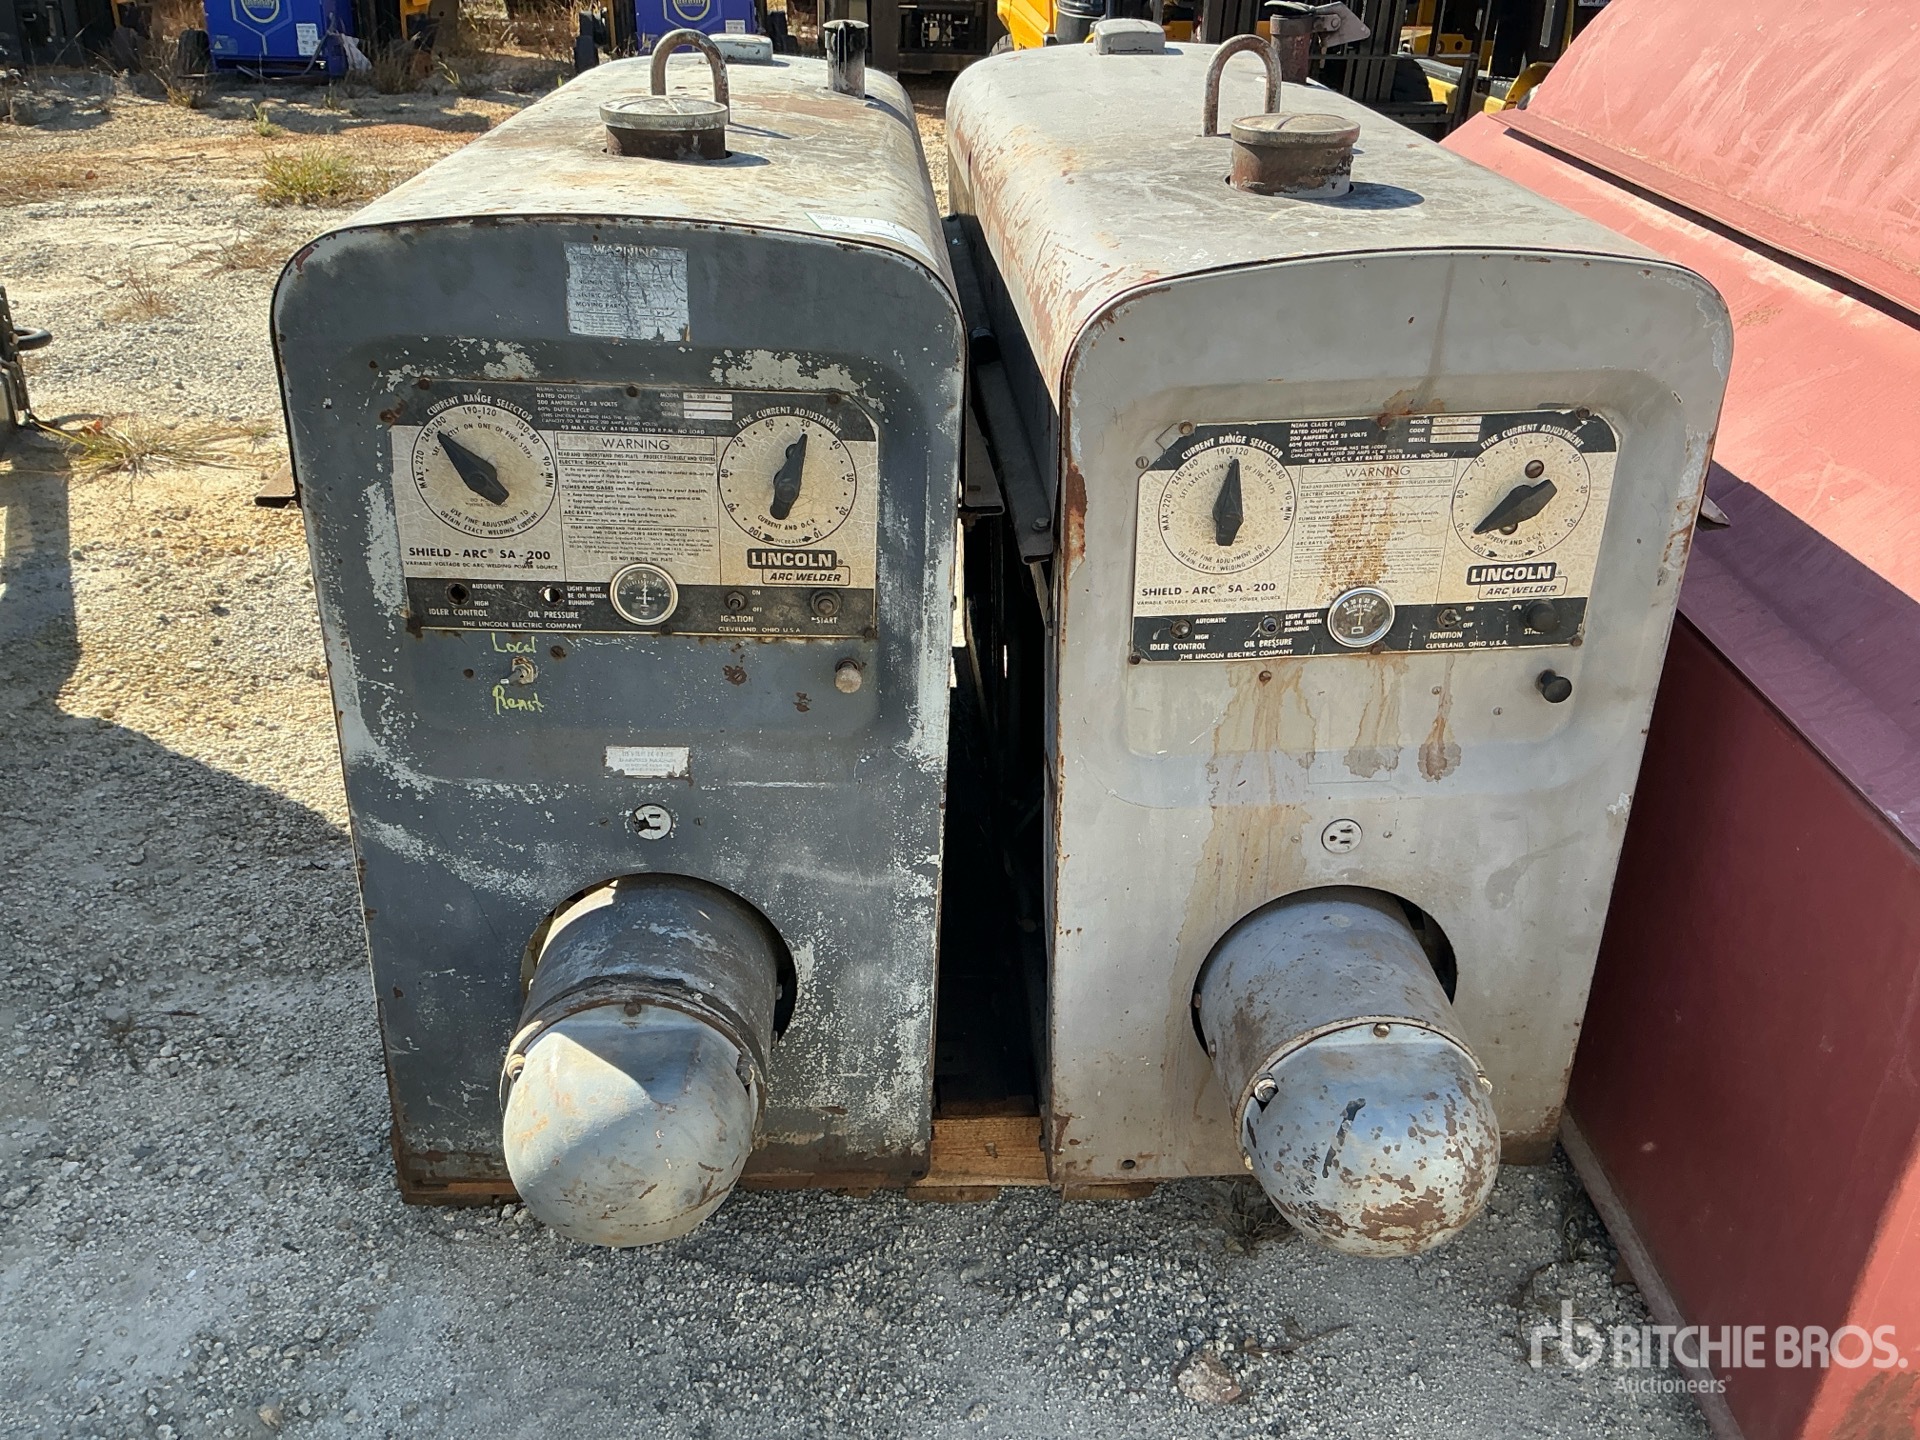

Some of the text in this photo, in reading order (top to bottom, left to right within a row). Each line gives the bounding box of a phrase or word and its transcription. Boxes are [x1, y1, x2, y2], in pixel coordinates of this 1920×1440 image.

[427, 396, 460, 416] CURRENT
[463, 394, 492, 404] RANGE
[496, 398, 533, 422] SELECTOR
[736, 414, 754, 429] FINE
[756, 406, 791, 419] CURRENT
[794, 406, 842, 434] ADJUSTMENT
[800, 419, 810, 427] 50
[733, 436, 743, 446] 70
[1480, 424, 1585, 450] FINE CURRENT ADJUSTMENT
[1509, 438, 1518, 446] 60
[601, 438, 670, 450] WARNING
[831, 440, 841, 450] 40
[1181, 436, 1284, 460] CURRENT RANGE SELECTOR
[1475, 457, 1484, 467] 70
[1571, 454, 1580, 463] 40
[1345, 466, 1411, 478] WARNING
[846, 473, 854, 482] 30
[1188, 469, 1211, 487] EXACTLY
[1580, 485, 1588, 494] 30
[482, 516, 518, 528] ADJUSTMENT
[758, 514, 782, 530] CURRENT
[488, 527, 515, 535] WELDING
[409, 548, 452, 557] SHIELD
[751, 552, 832, 567] LINCOLN
[770, 573, 842, 582] ARC WELDER
[1470, 566, 1552, 582] LINCOLN
[1142, 588, 1182, 596] SHIELD
[1254, 583, 1276, 592] 200
[1486, 585, 1557, 595] ARC WELDER
[428, 608, 488, 617] IDLER CONTROL
[544, 611, 579, 619] PRESSURE
[816, 616, 838, 624] START
[1430, 631, 1463, 639] IGNITION
[491, 632, 537, 653] Local
[1259, 638, 1293, 647] PRESSURE
